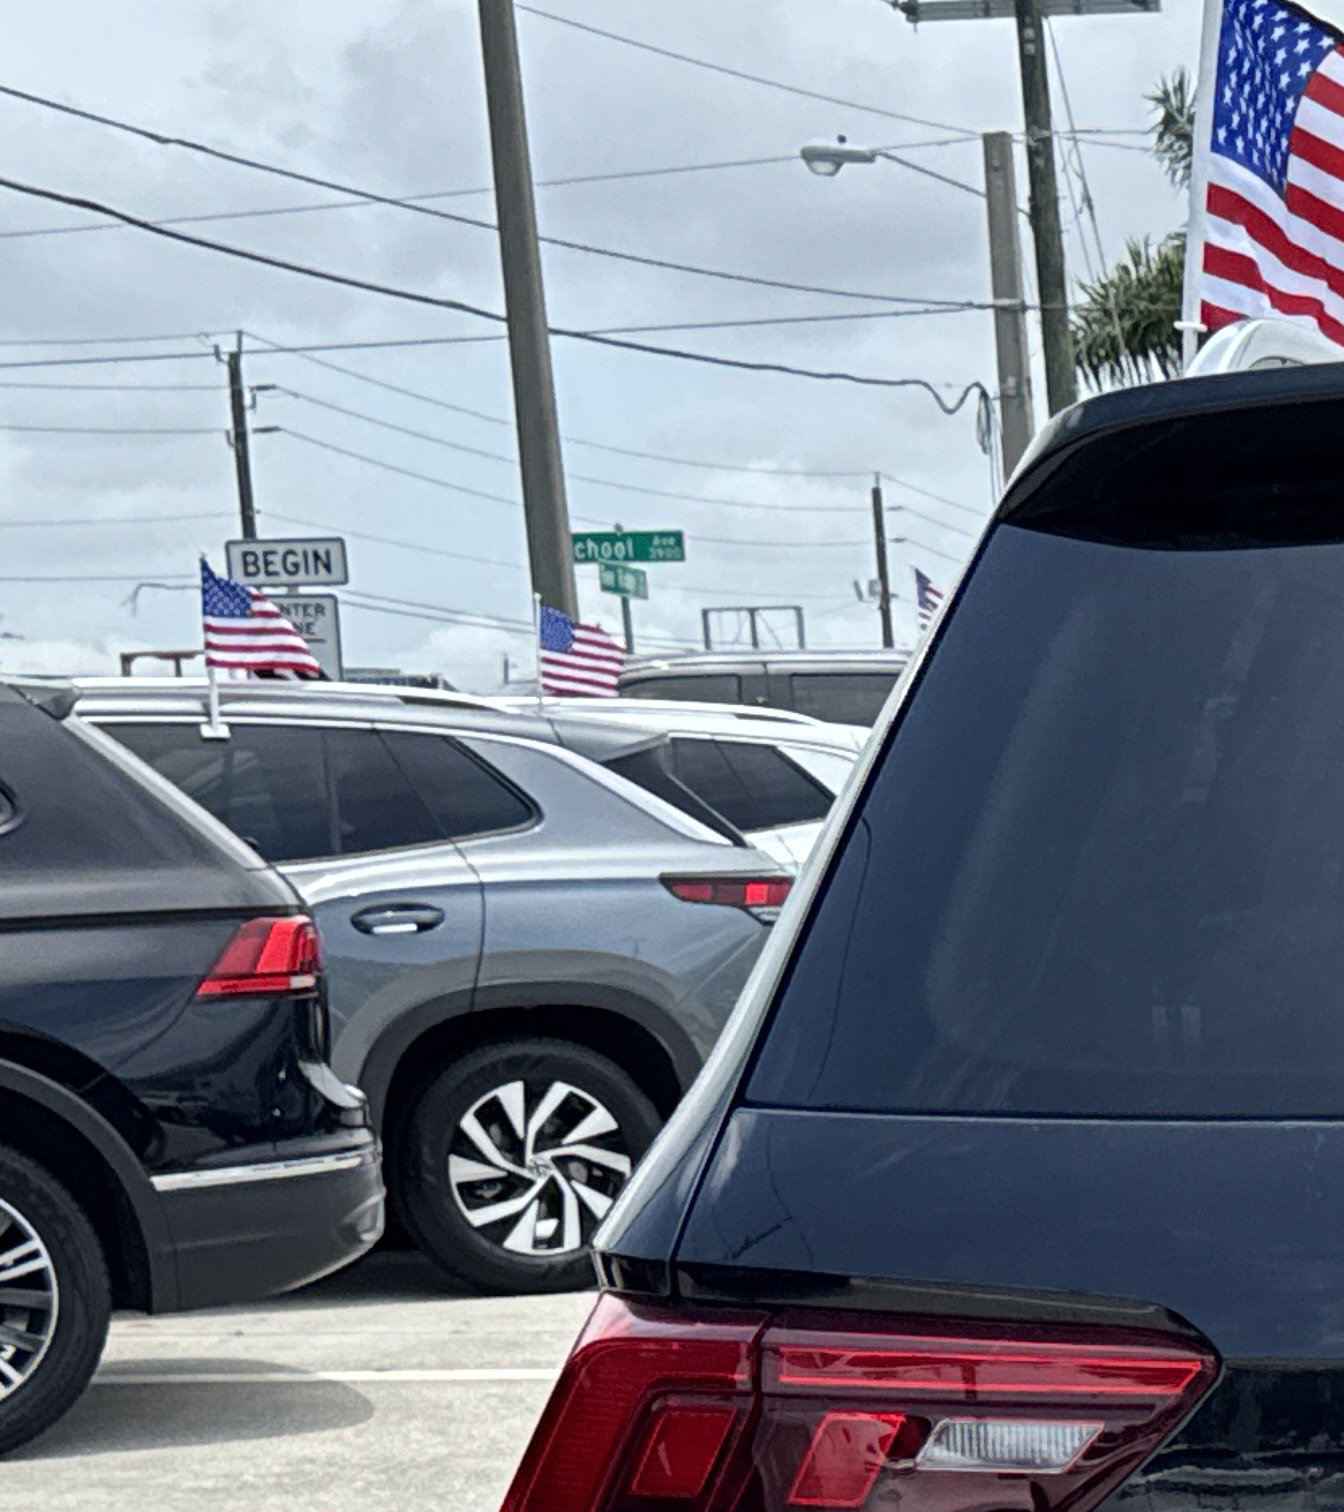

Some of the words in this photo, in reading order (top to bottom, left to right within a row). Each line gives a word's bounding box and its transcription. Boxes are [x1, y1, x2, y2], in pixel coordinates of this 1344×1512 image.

[574, 538, 634, 559] chool
[242, 550, 332, 577] BEGIN
[279, 602, 325, 617] NTER
